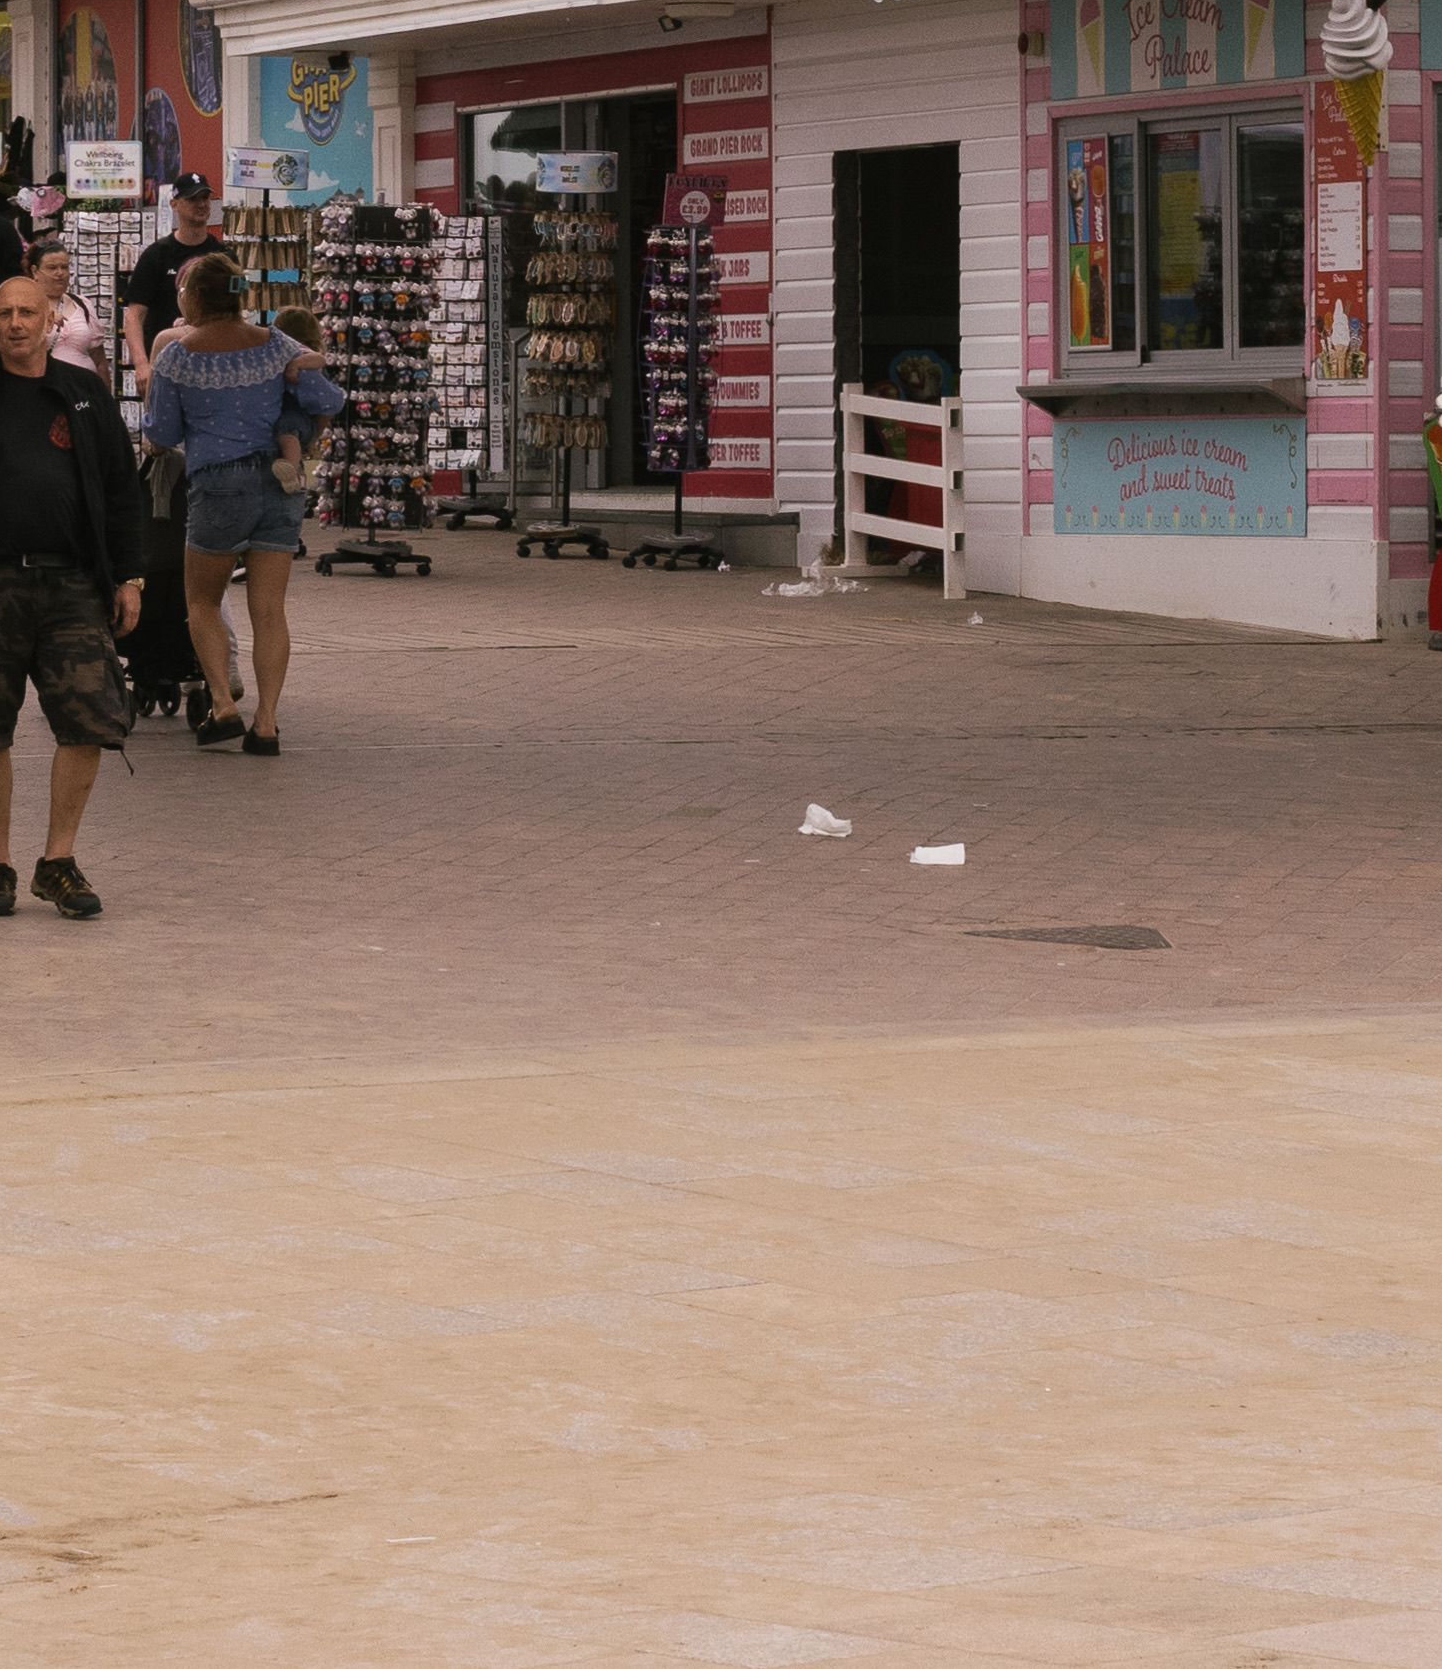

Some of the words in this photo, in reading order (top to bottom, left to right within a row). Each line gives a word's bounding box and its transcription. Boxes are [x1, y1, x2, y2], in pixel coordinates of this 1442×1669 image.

[1145, 34, 1211, 79] Palace
[690, 76, 715, 97] GIANT
[717, 72, 763, 95] LOLLIPOPS
[690, 136, 718, 157] GRAND
[720, 135, 740, 155] PIER
[741, 132, 763, 153] ROCK
[1108, 432, 1177, 470] Delicious
[1182, 430, 1201, 456] ice
[1204, 438, 1248, 471] cream
[1120, 464, 1149, 501] and
[1153, 464, 1191, 491] sweet
[1195, 465, 1235, 500] treats
